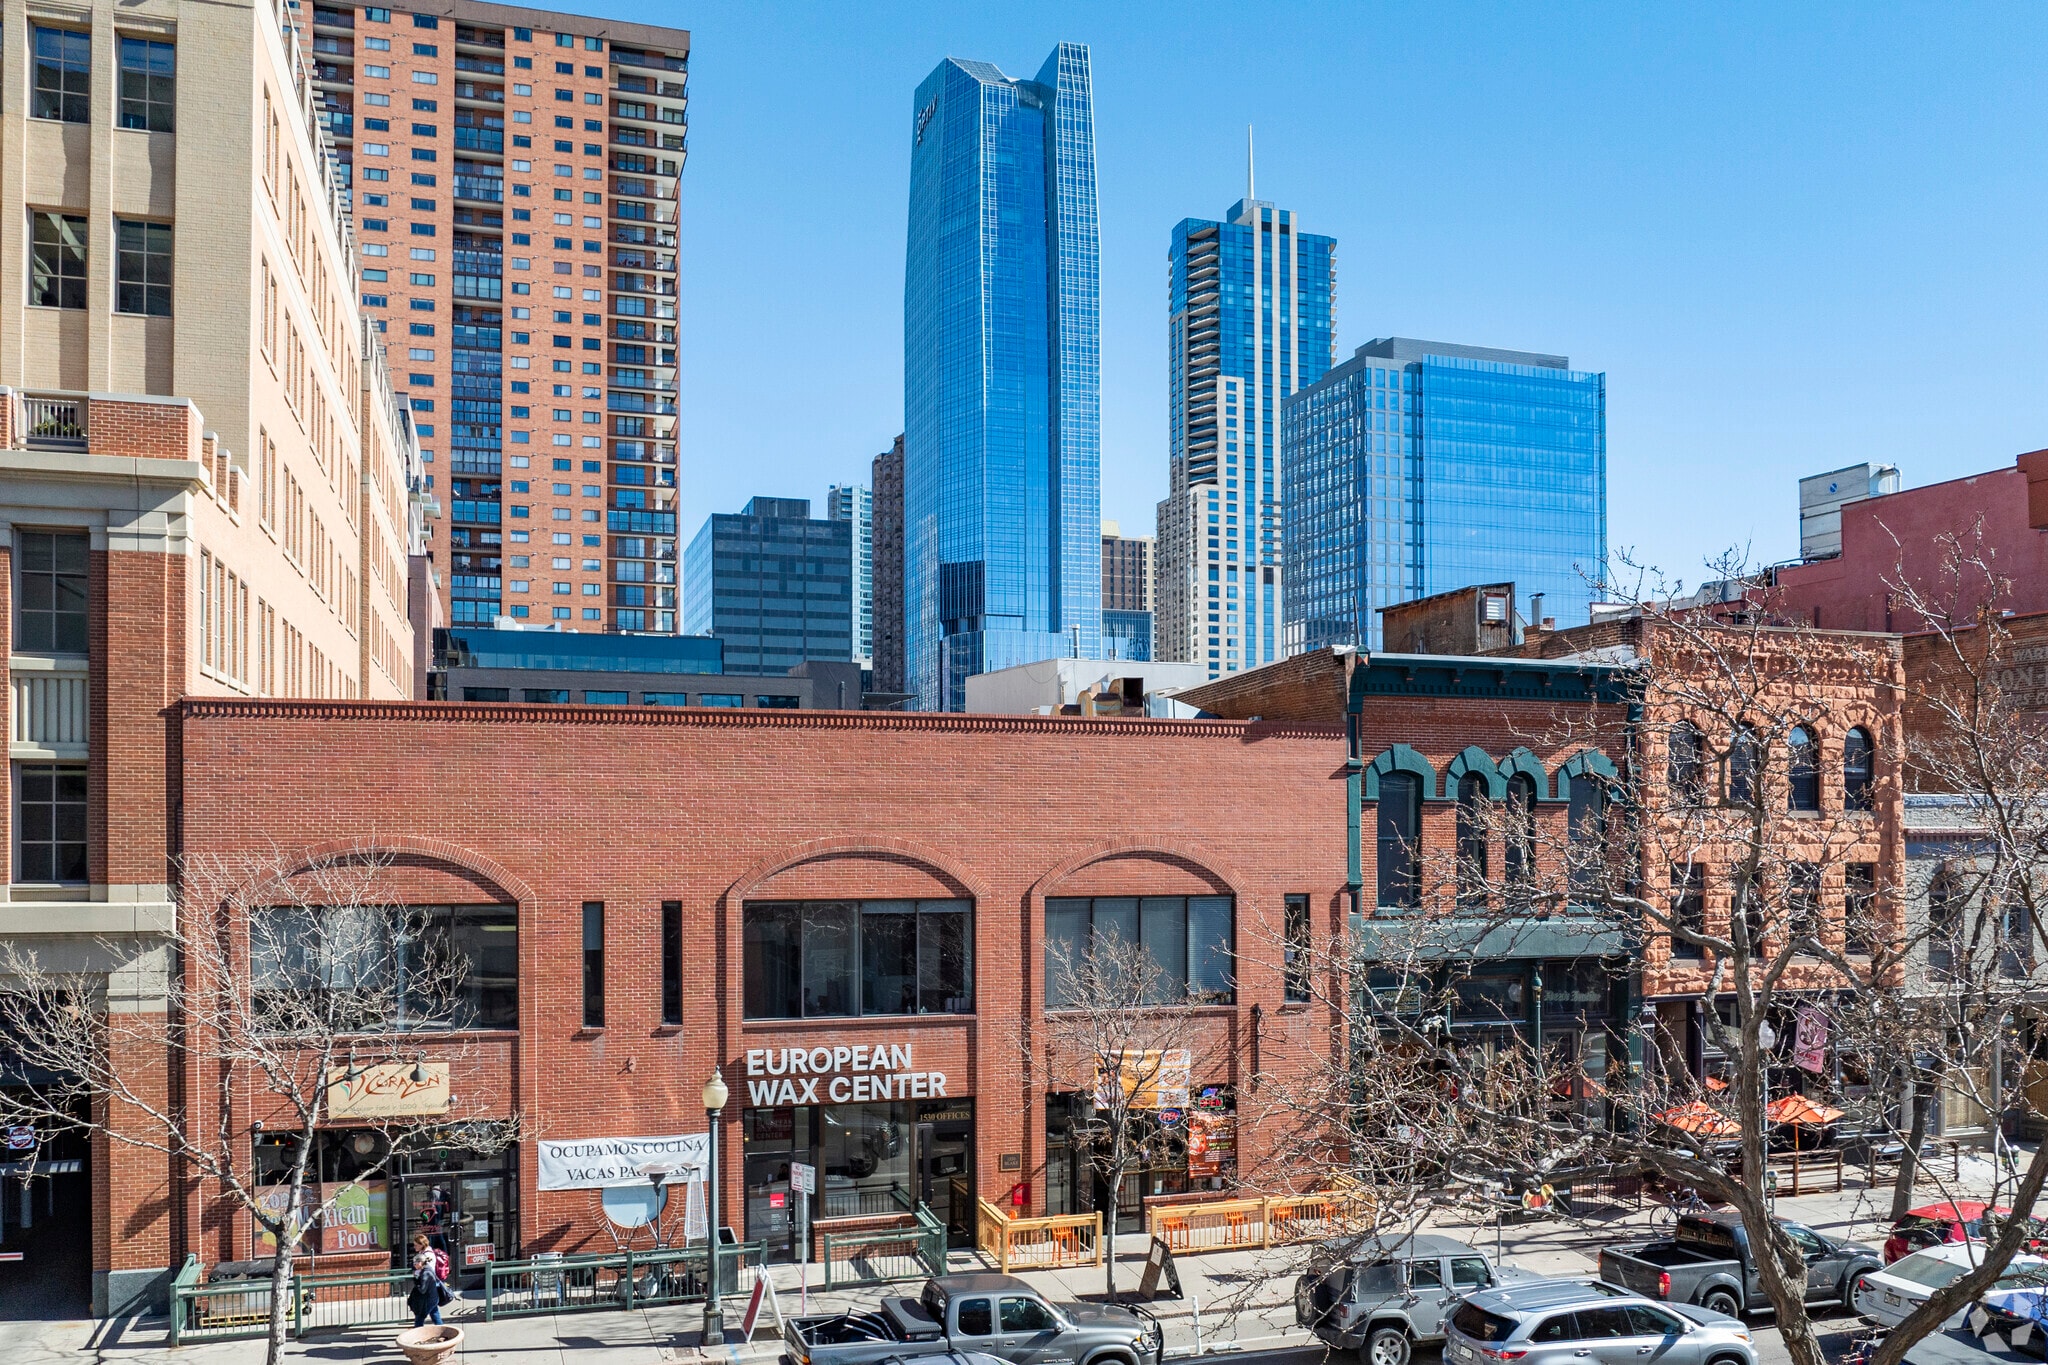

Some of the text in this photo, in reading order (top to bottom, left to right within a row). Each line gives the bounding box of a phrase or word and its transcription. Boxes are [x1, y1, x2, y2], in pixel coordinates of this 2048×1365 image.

[747, 1043, 912, 1076] EUROPEAN
[747, 1072, 947, 1106] WAX CENTER
[1199, 1100, 1223, 1108] OPEN
[920, 1111, 970, 1121] 1530 OFFICES
[550, 1140, 704, 1159] OCUPAMOS COCINA
[567, 1167, 615, 1181] VACAS
[338, 1226, 378, 1249] Food
[467, 1245, 494, 1255] ABIERTO
